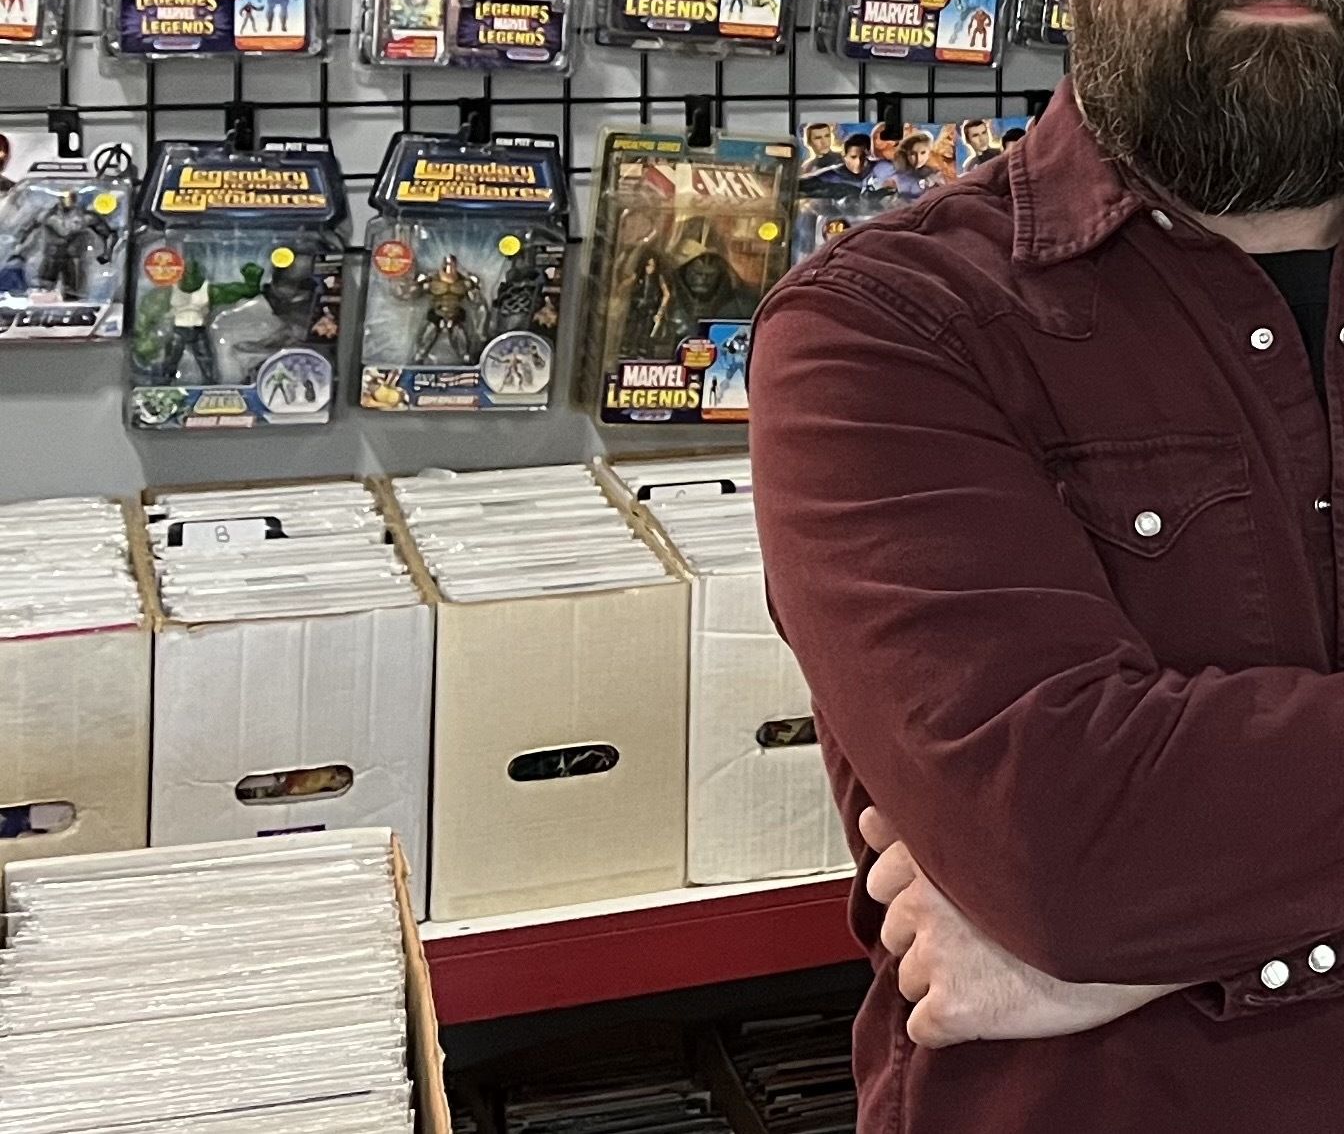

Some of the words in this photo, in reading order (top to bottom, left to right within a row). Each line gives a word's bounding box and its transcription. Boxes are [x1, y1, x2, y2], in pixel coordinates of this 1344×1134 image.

[863, 2, 921, 25] MARVEL
[141, 17, 214, 35] LEGENDS
[479, 26, 545, 46] LEGENDS
[849, 17, 936, 48] LEGENDS
[644, 161, 767, 201] X-MEN
[622, 365, 685, 388] MARVEL
[607, 383, 700, 409] LEGENDS
[214, 525, 230, 543] B
